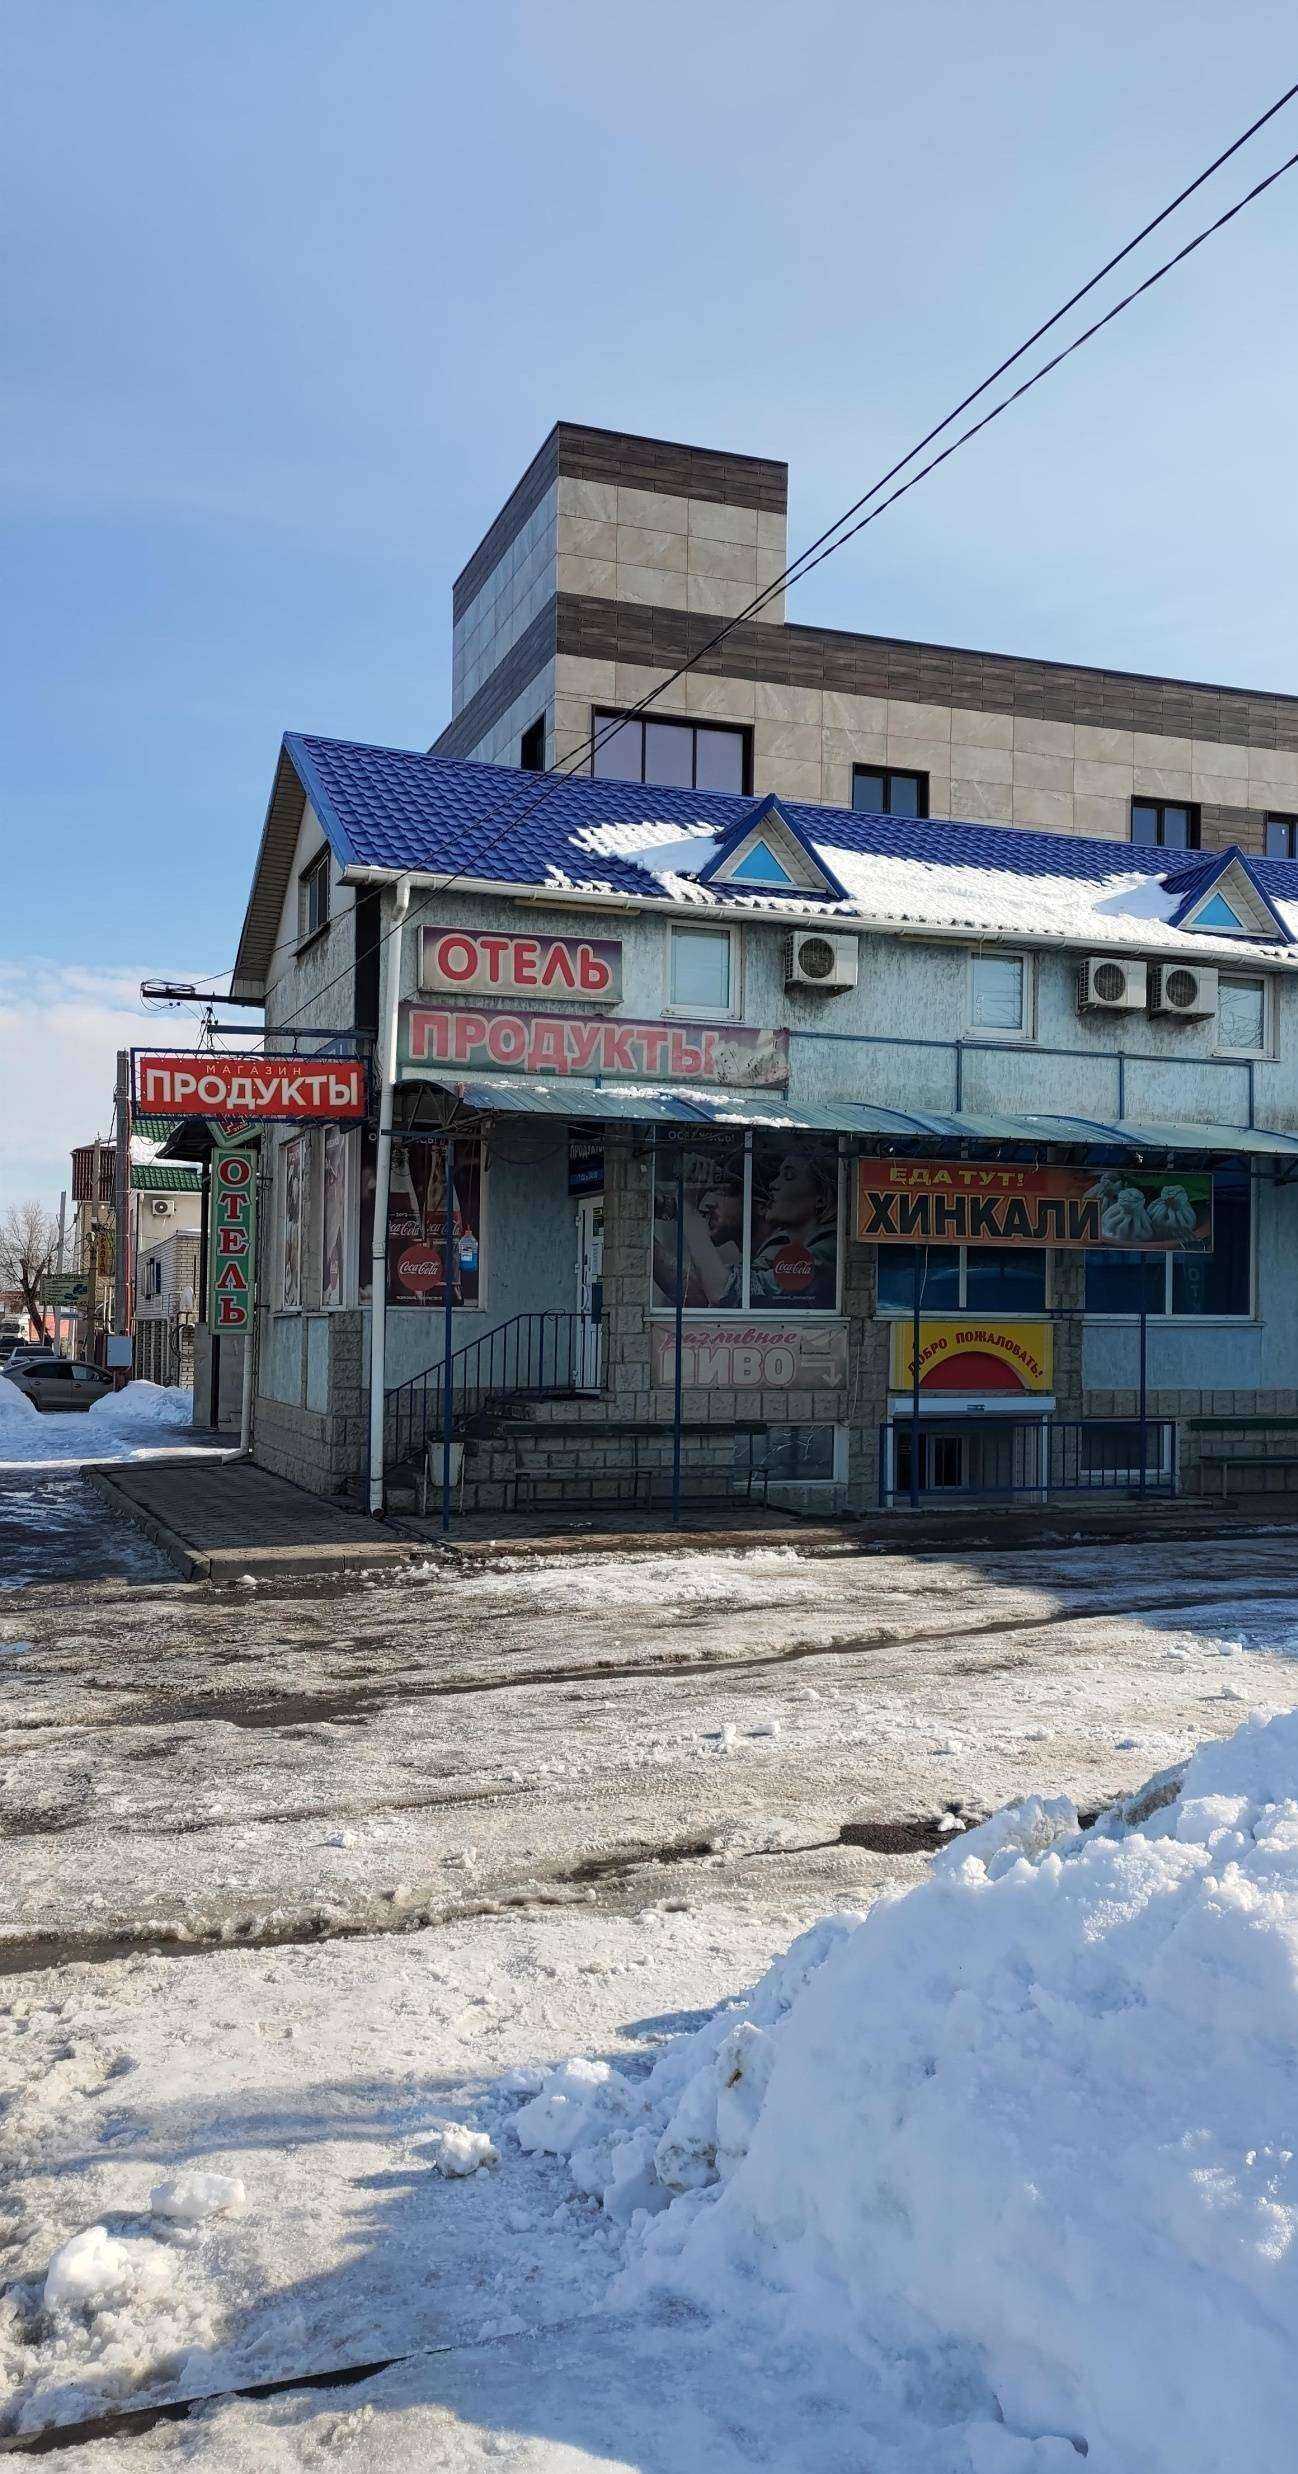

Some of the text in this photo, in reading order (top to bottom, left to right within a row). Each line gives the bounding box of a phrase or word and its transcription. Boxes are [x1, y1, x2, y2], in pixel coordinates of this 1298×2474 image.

[437, 934, 612, 991] ОТЕЛЬ
[144, 1069, 358, 1110] ПРОДУКТЫ
[206, 1064, 302, 1076] МАГАЗИН
[889, 1167, 1025, 1188] ЕДА ТУТ!
[864, 1191, 1100, 1241] ХИНКАЛИ
[217, 1157, 251, 1326] ОТЕЛЬ
[662, 1347, 795, 1387] ПИВО
[955, 1330, 1044, 1379] ПОЖАЛОВАТЬ!
